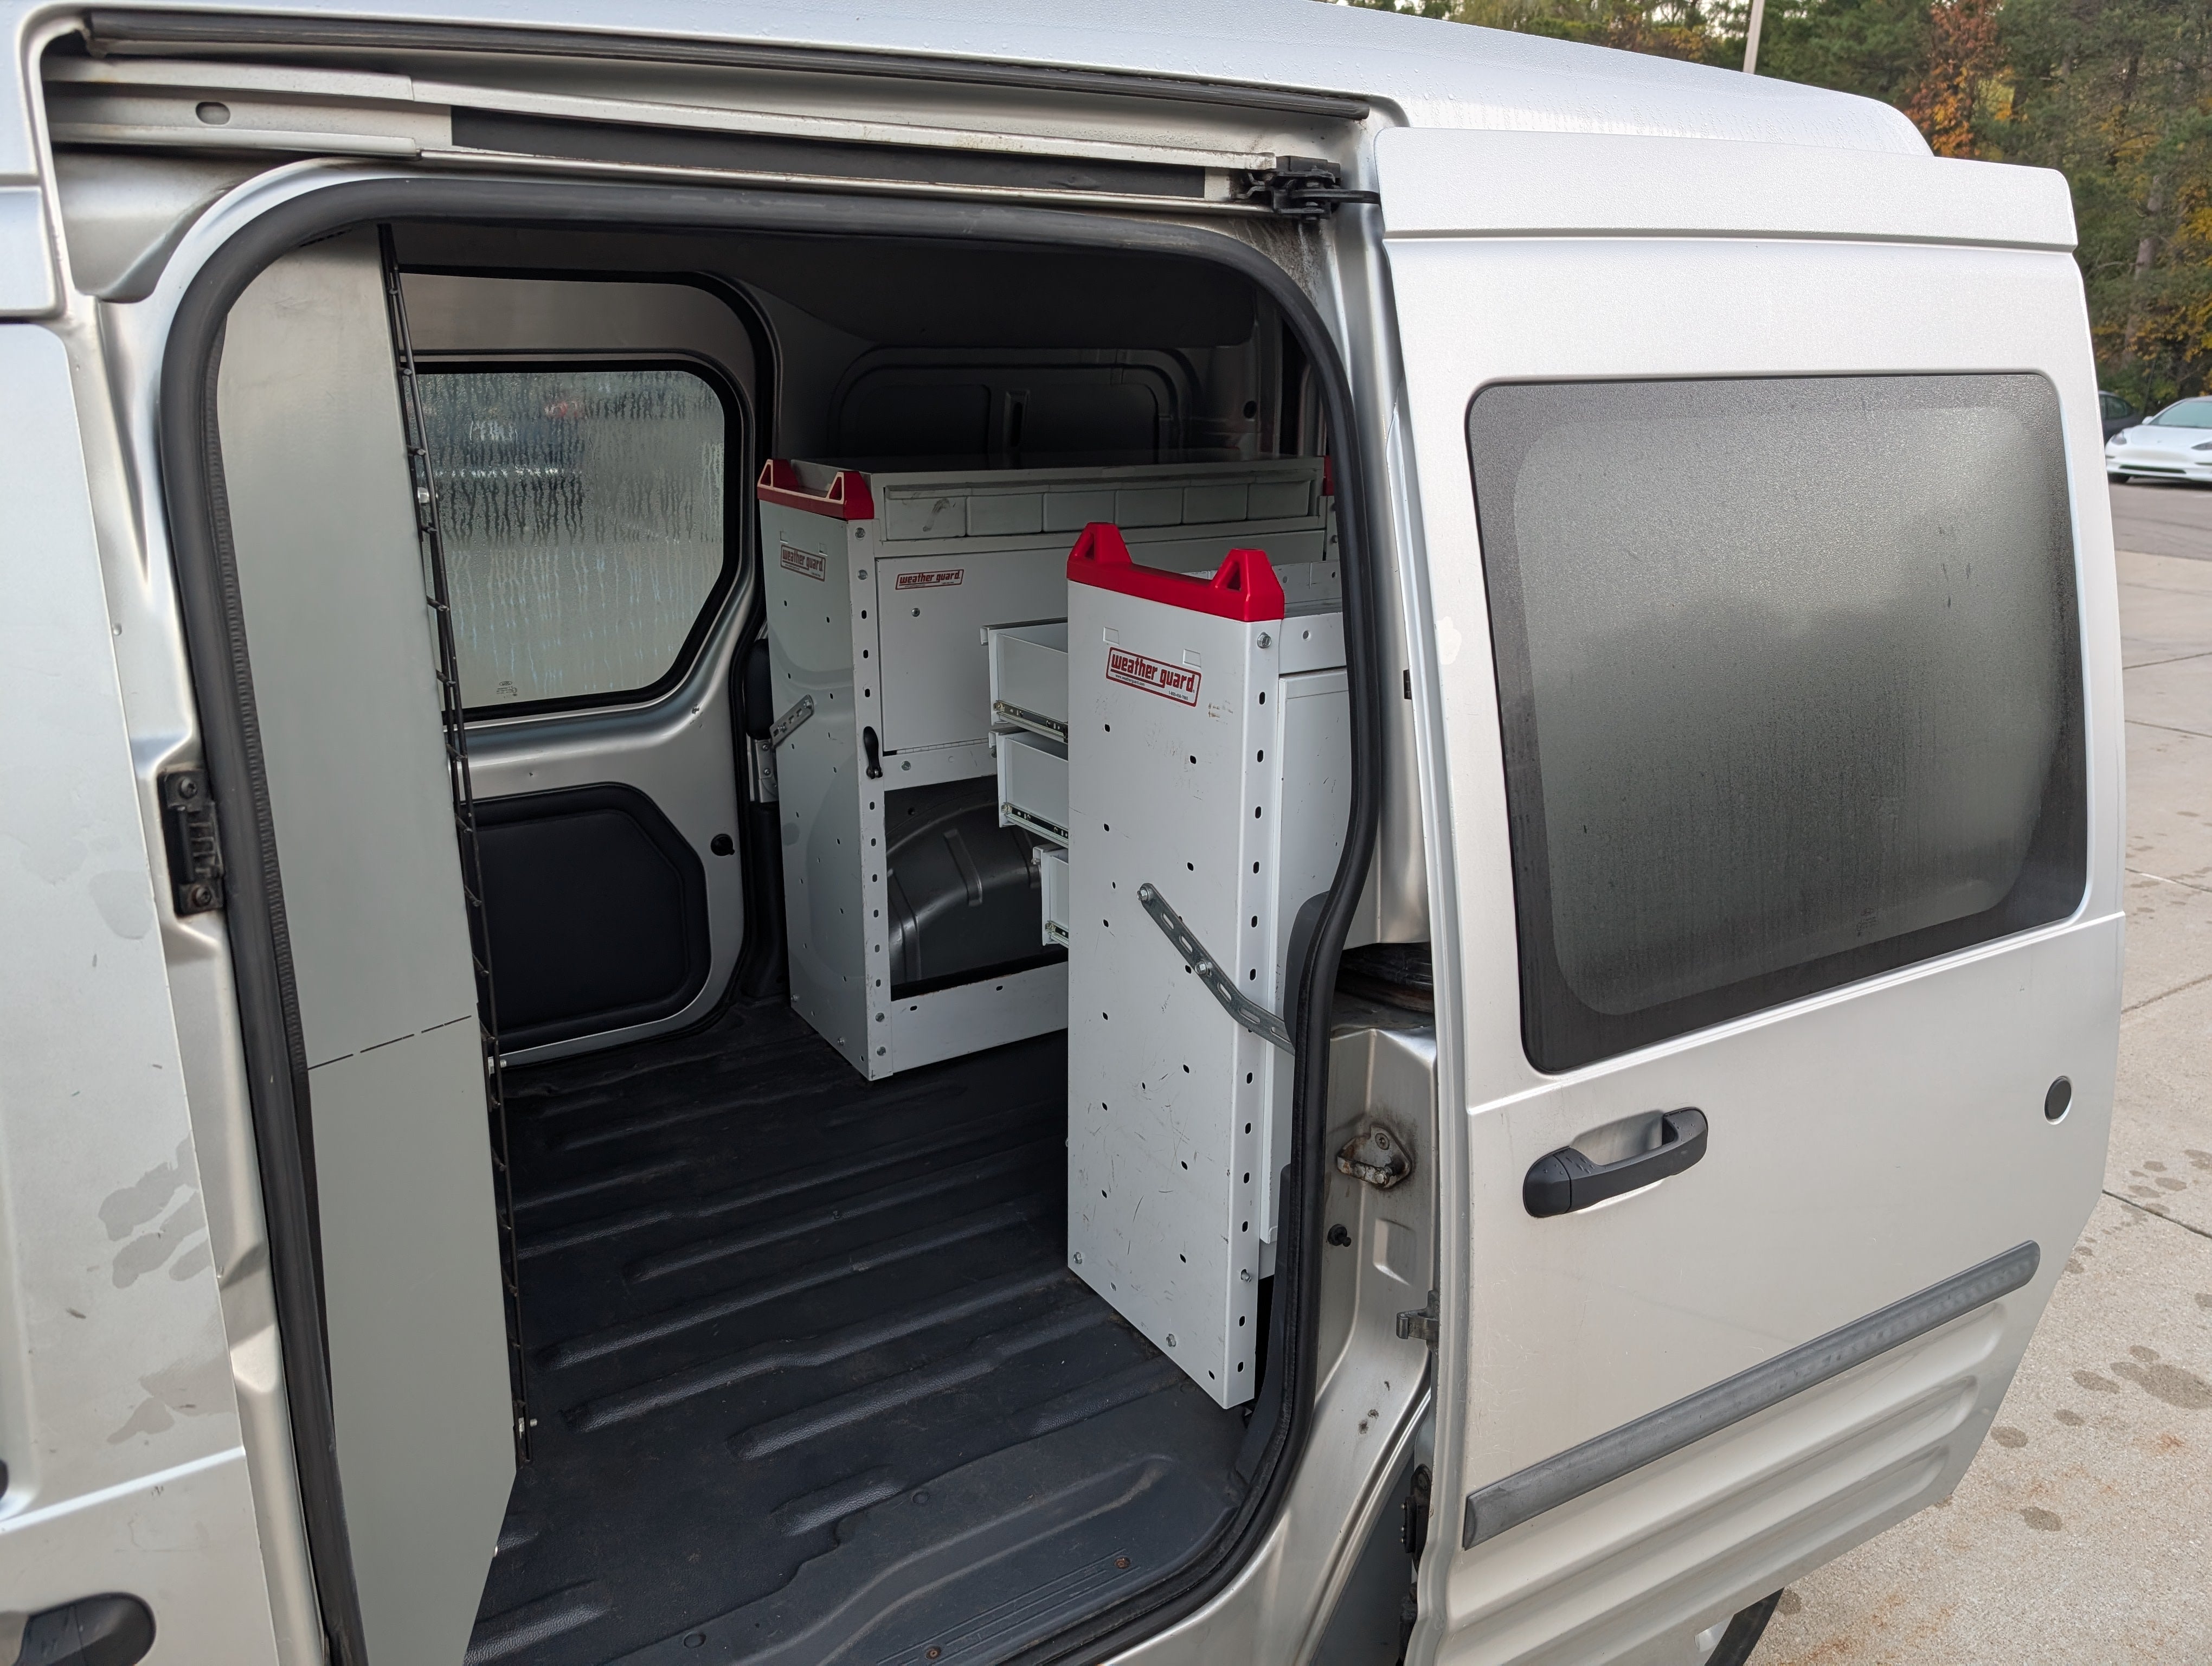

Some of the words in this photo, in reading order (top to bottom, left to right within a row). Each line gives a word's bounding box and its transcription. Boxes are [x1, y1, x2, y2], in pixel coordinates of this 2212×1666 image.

[782, 549, 805, 565] weather
[806, 557, 823, 572] guard
[899, 573, 935, 584] weather
[936, 570, 960, 582] guard
[1111, 653, 1158, 680] weather
[1160, 669, 1195, 693] guard
